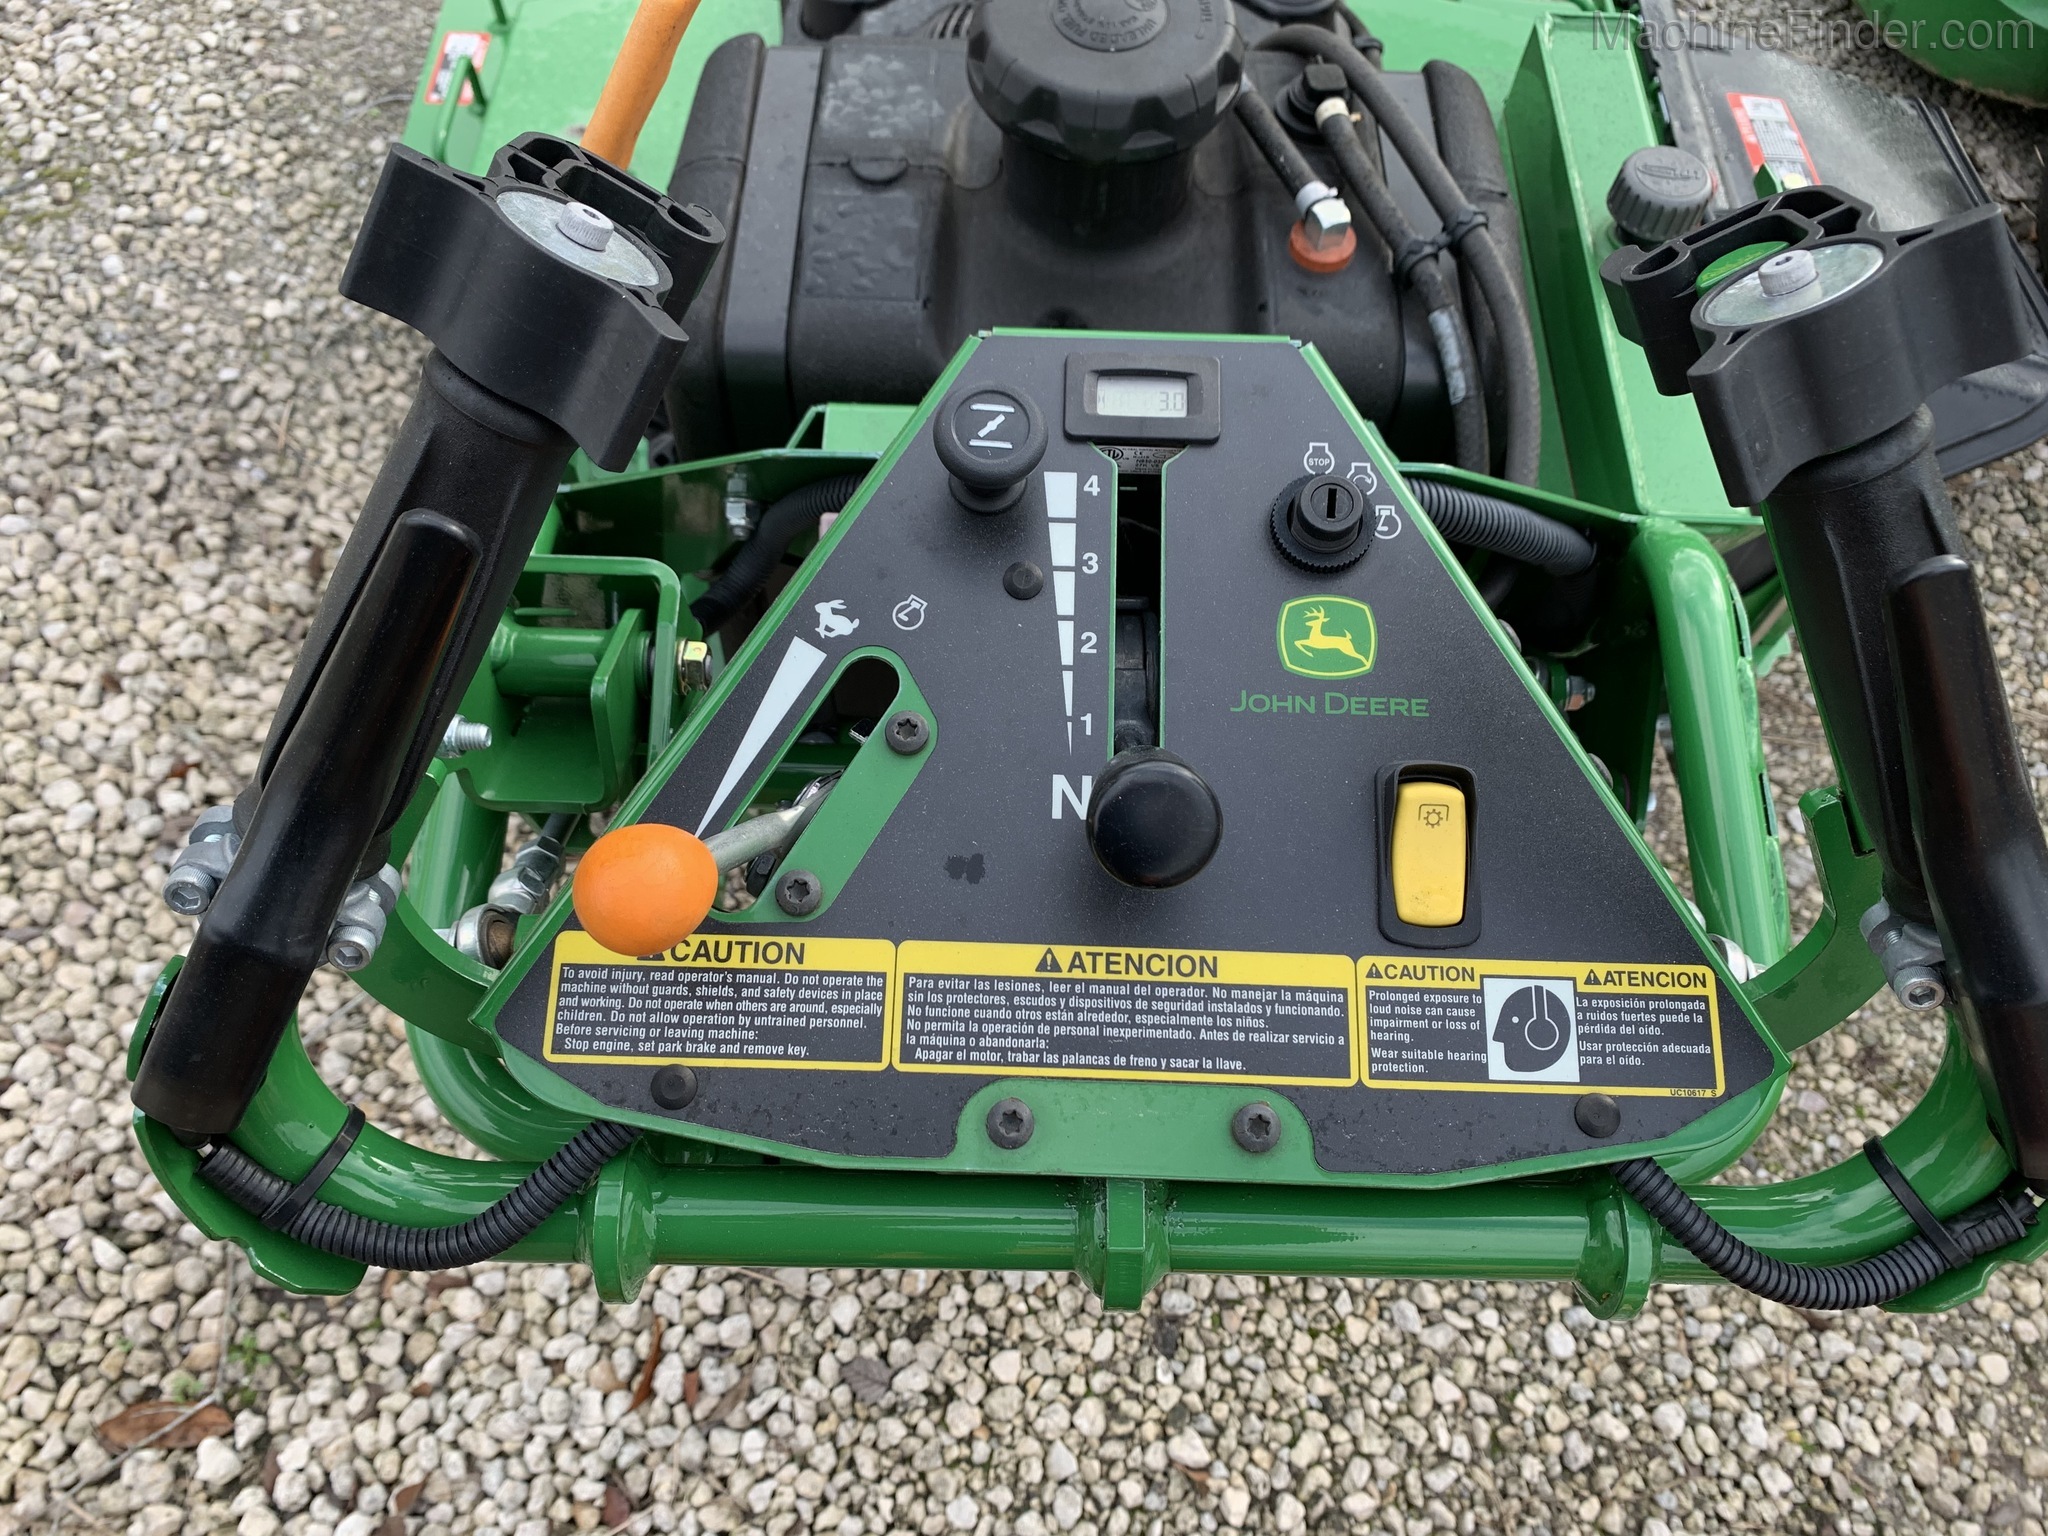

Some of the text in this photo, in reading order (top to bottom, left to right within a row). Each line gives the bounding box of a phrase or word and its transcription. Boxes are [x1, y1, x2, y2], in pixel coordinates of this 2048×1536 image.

[1159, 391, 1185, 411] 3.0
[1308, 457, 1330, 466] STOP
[1082, 473, 1101, 497] 4
[1082, 552, 1099, 574] 3
[1080, 631, 1097, 654] 2
[1230, 689, 1430, 717] JOHN DEERE
[1081, 713, 1093, 736] 1
[1051, 774, 1093, 820] N
[670, 939, 805, 965] CAUTION
[1067, 951, 1218, 978] ATENCION
[1384, 964, 1475, 982] CAUTION
[563, 967, 883, 987] To avoid injury, read operator's manual. Do not operate the
[1603, 970, 1707, 988] ATENCION
[560, 981, 883, 1002] machine without guards, shields, and safety devices in place
[908, 976, 1344, 1004] Para evitar las lesiones, leer el manual del operador. No manejar máquina
[1369, 990, 1482, 1004] Prolonged exposure to
[558, 995, 882, 1016] and working. Do not operate when others are around, especially
[907, 991, 1344, 1015] sin los protectores, escudos dispositivos de seguridad instalados funcionando.
[1369, 1003, 1391, 1014] loud
[1394, 1004, 1422, 1014] noise
[1425, 1007, 1443, 1015] can
[1576, 996, 1705, 1011] La exposición prolongada
[557, 1009, 866, 1029] children. Do not allow operation by untrained personnel.
[907, 1004, 1268, 1027] No funcione cuando otros están alrededor, especialmente los niños.
[1370, 1016, 1480, 1030] impairment or loss of
[1586, 1010, 1690, 1024] ruidos fuertes puede
[555, 1023, 758, 1040] Before servicing or leaving machine:
[906, 1019, 1334, 1043] No permita operación de personal inexperimentado. Antes de realizar servicio
[1370, 1029, 1413, 1043] hearing.
[1577, 1023, 1664, 1036] pérdida del oído.
[564, 1037, 809, 1057] Stop engine, set park brake and remove key.
[919, 1033, 1048, 1048] máquina abandonarla:
[1579, 1040, 1710, 1054] Usar protección adecuada
[914, 1048, 1246, 1069] Apagar el motor, trabar las palancas de freno sacar llave.
[1371, 1047, 1486, 1063] Wear suitable hearing
[1579, 1054, 1644, 1067] para el oído.
[1371, 1061, 1428, 1074] protection.
[1670, 1088, 1706, 1097] UC10617
